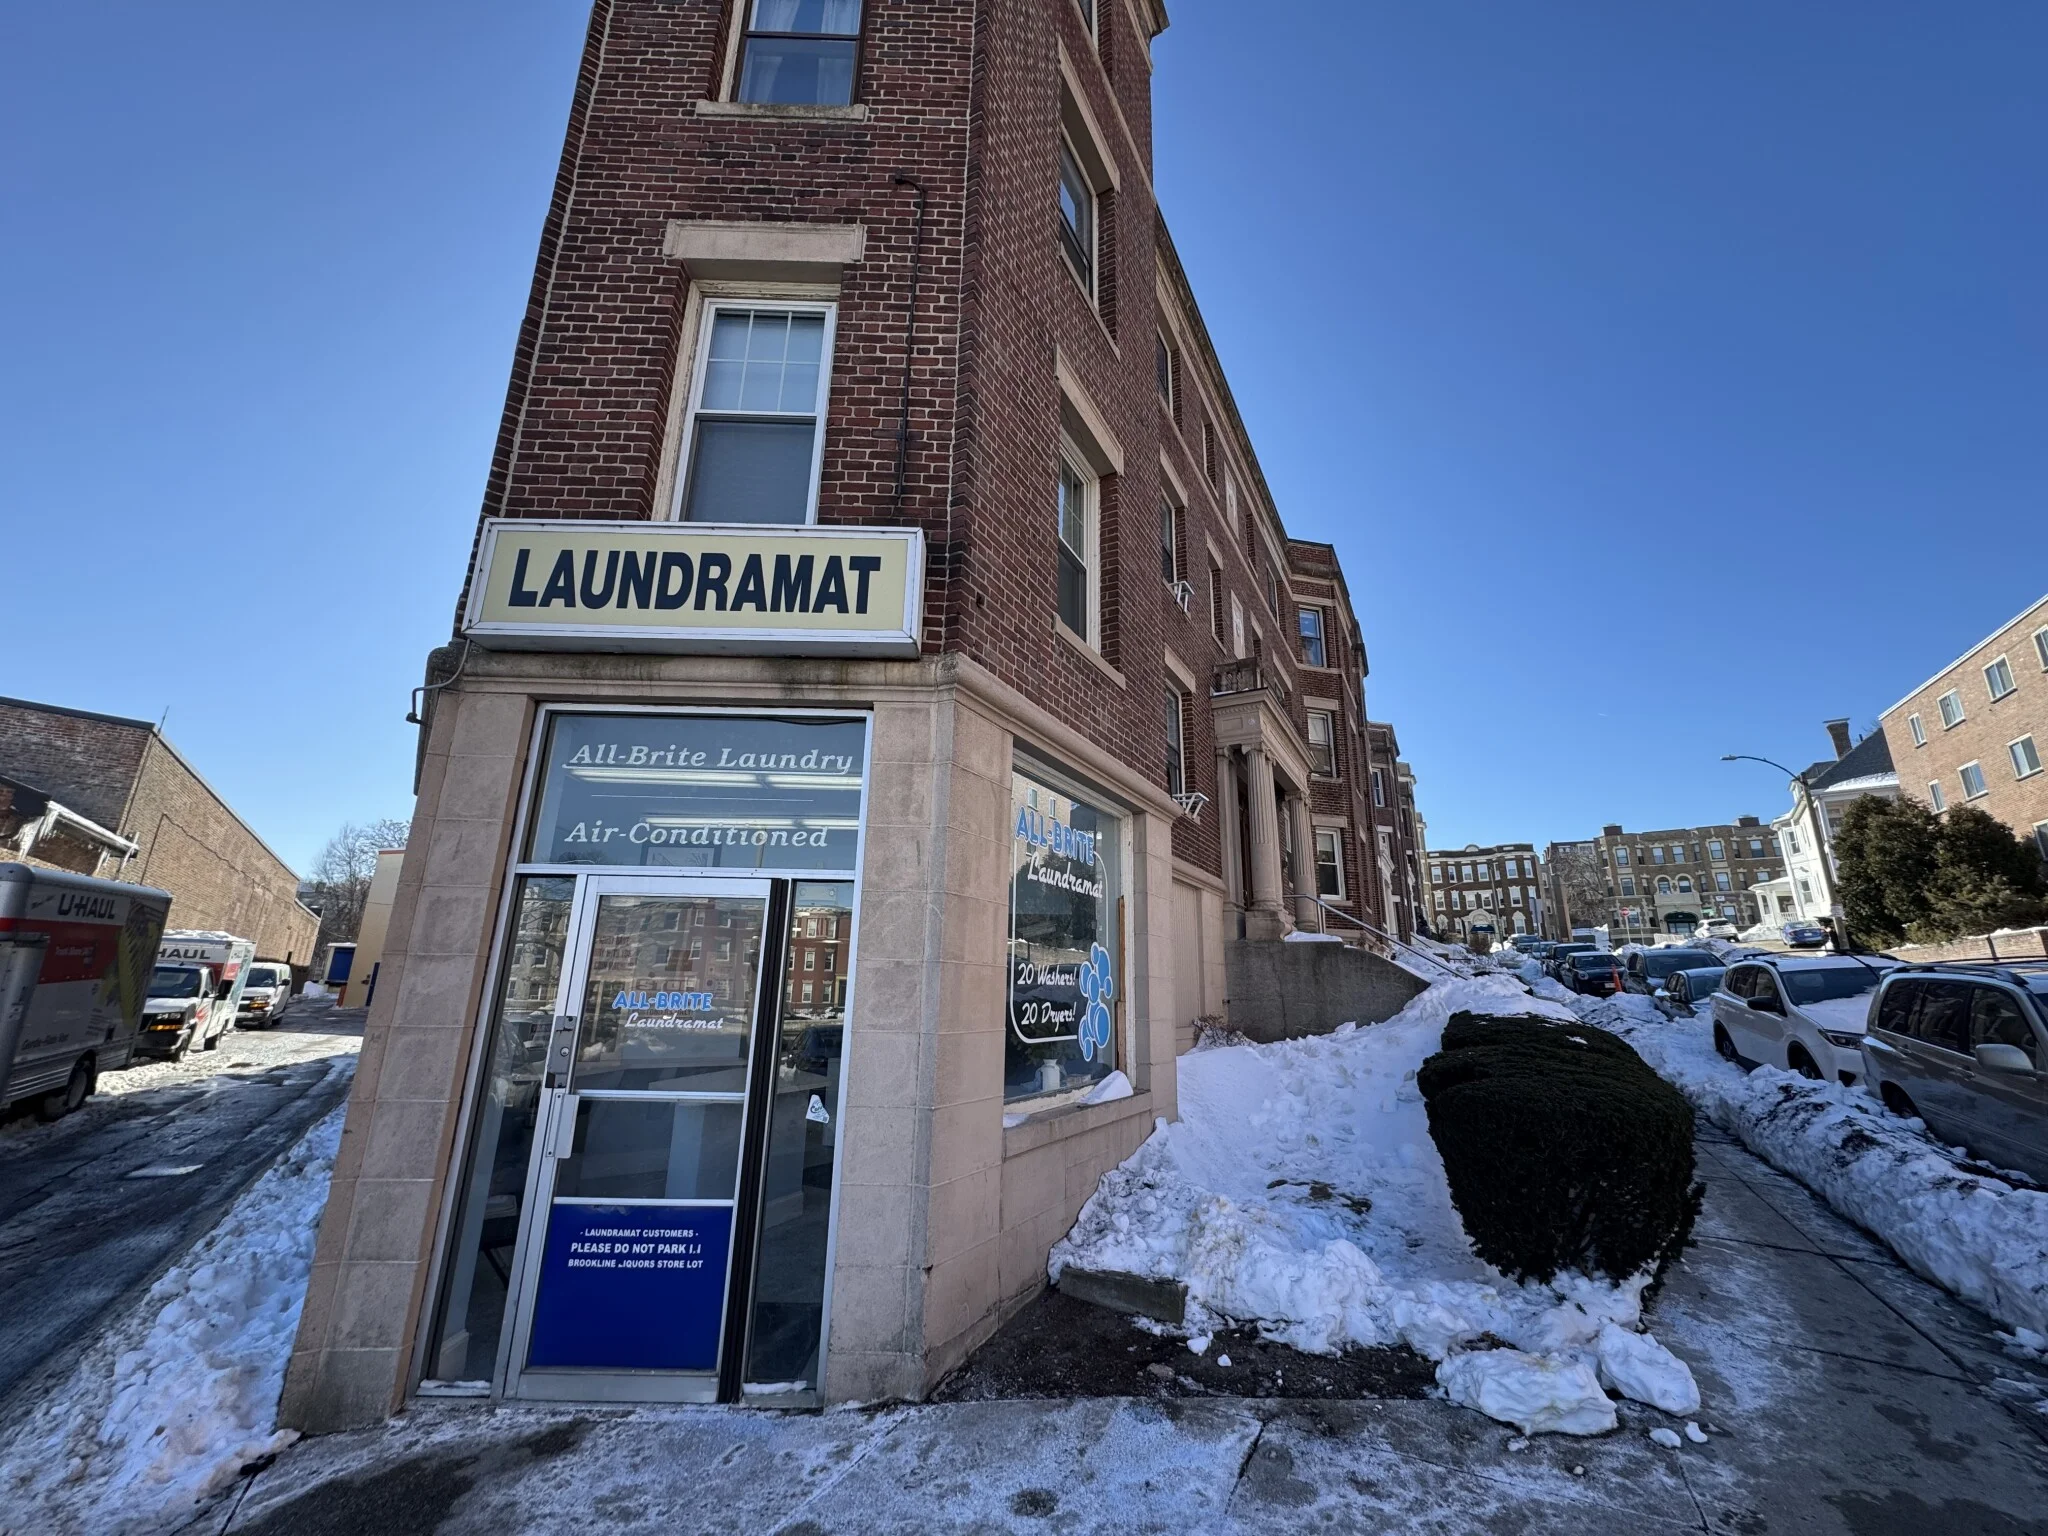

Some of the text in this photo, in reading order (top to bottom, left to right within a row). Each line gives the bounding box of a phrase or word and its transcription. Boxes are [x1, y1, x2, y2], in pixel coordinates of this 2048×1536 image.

[508, 548, 882, 615] LAUNDRAMAT
[570, 744, 853, 775] All-Brite Laundry
[564, 820, 829, 848] Air-Conditioned
[1015, 805, 1095, 867] ALL-BRITE
[1027, 851, 1103, 899] Laundramat
[57, 893, 116, 920] U-HAUL
[1017, 962, 1078, 986] 20 Washers!
[612, 990, 714, 1012] ALL-BRITE
[624, 1012, 724, 1030] Laundramat
[1021, 1001, 1078, 1033] 20 Dryers!
[584, 1228, 641, 1237] LAUNDRAMAT
[642, 1229, 694, 1238] CUSTOMERS
[570, 1242, 612, 1253] PLEASE
[614, 1243, 630, 1254] DO
[632, 1243, 655, 1254] NOT
[657, 1243, 687, 1254] PARK
[567, 1258, 617, 1268] BROOKLINE
[656, 1259, 685, 1269] STORE
[686, 1259, 704, 1269] LOT
